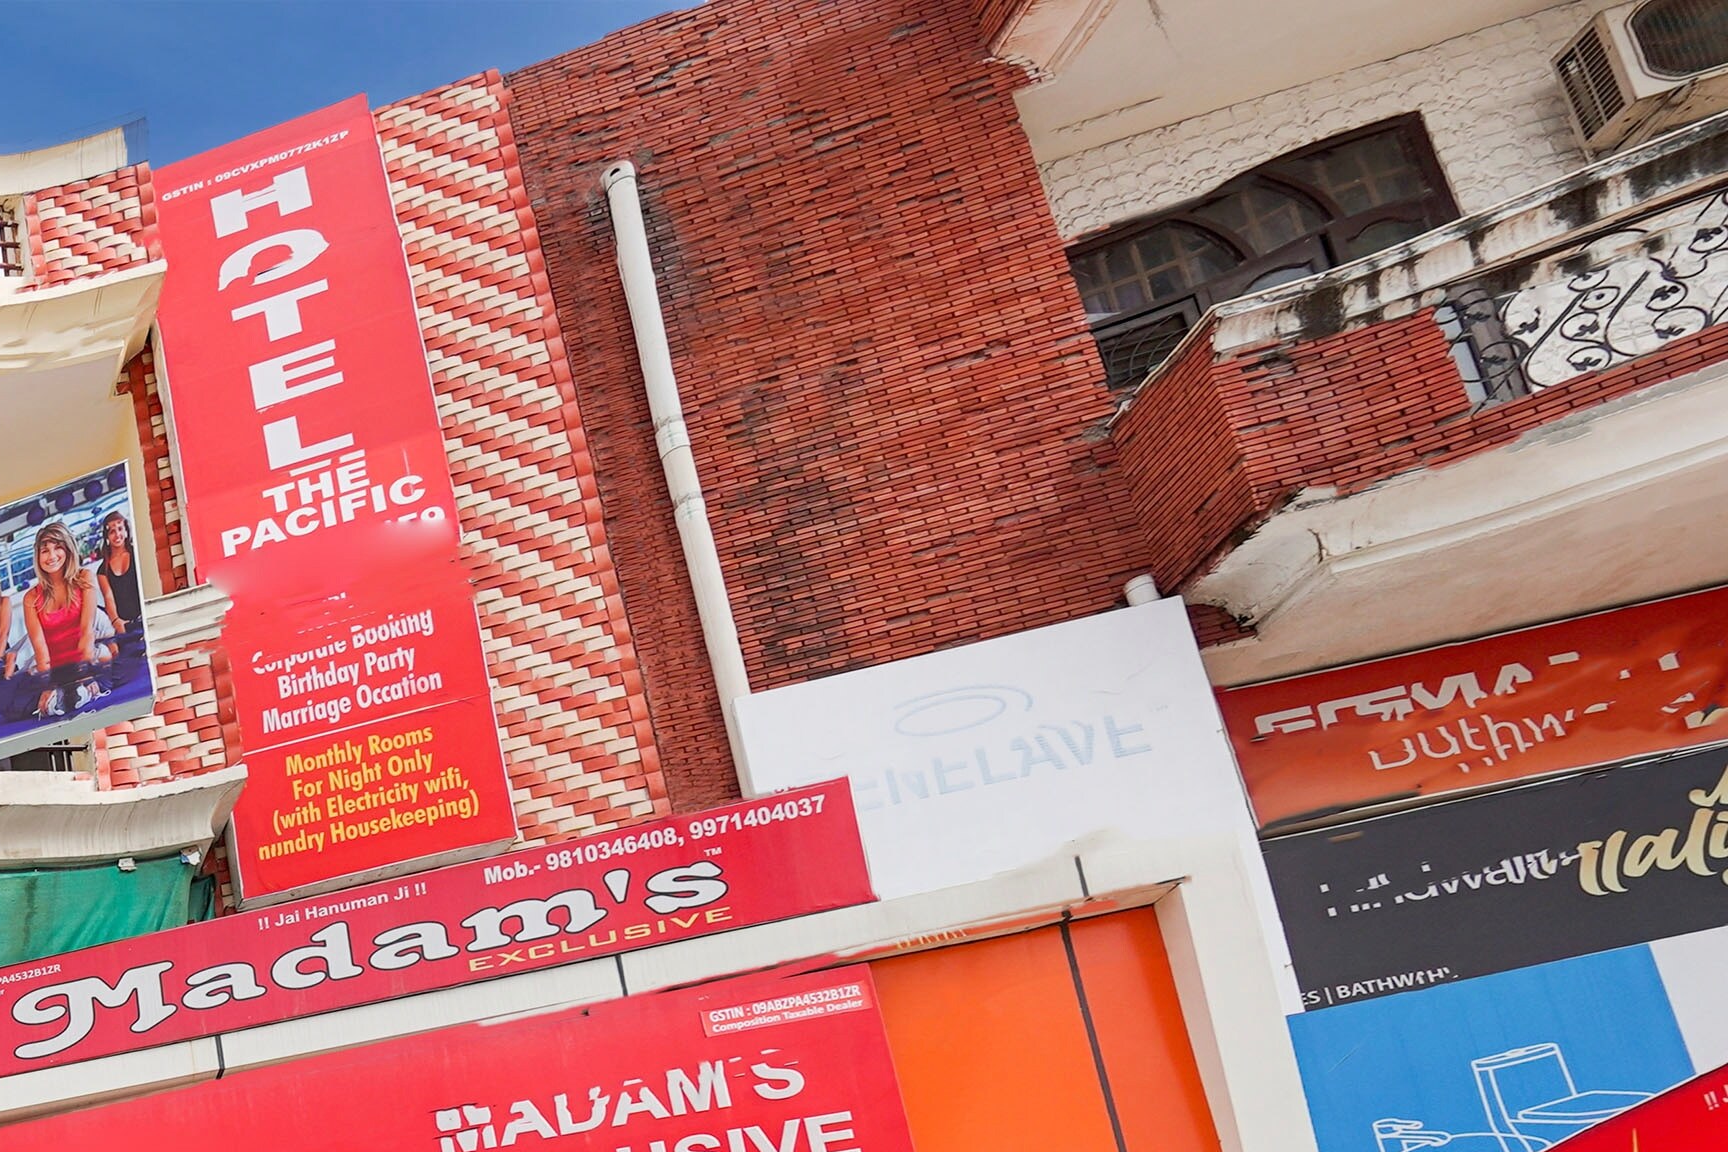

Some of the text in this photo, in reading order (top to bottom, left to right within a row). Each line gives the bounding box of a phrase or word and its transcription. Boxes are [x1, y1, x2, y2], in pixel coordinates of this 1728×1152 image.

[162, 180, 204, 201] GSTIN
[210, 165, 354, 470] HOTEL
[262, 455, 371, 512] THE
[221, 474, 426, 558] PACIFIC
[277, 646, 415, 699] Birthday Party
[261, 672, 443, 734] Marriage Occation
[285, 726, 433, 777] Monthly Rooms
[292, 751, 433, 801] For Night Only
[272, 781, 419, 835] (with Electricity
[330, 790, 480, 844] Housekeeping)
[688, 794, 826, 840] 9971404037
[274, 884, 410, 928] Jai Hanuman Ji
[11, 860, 729, 1060] Madam's
[468, 907, 733, 972] EXCLUSIVE
[709, 1006, 744, 1023] GSTIN
[712, 998, 863, 1033] Composition Dealer
